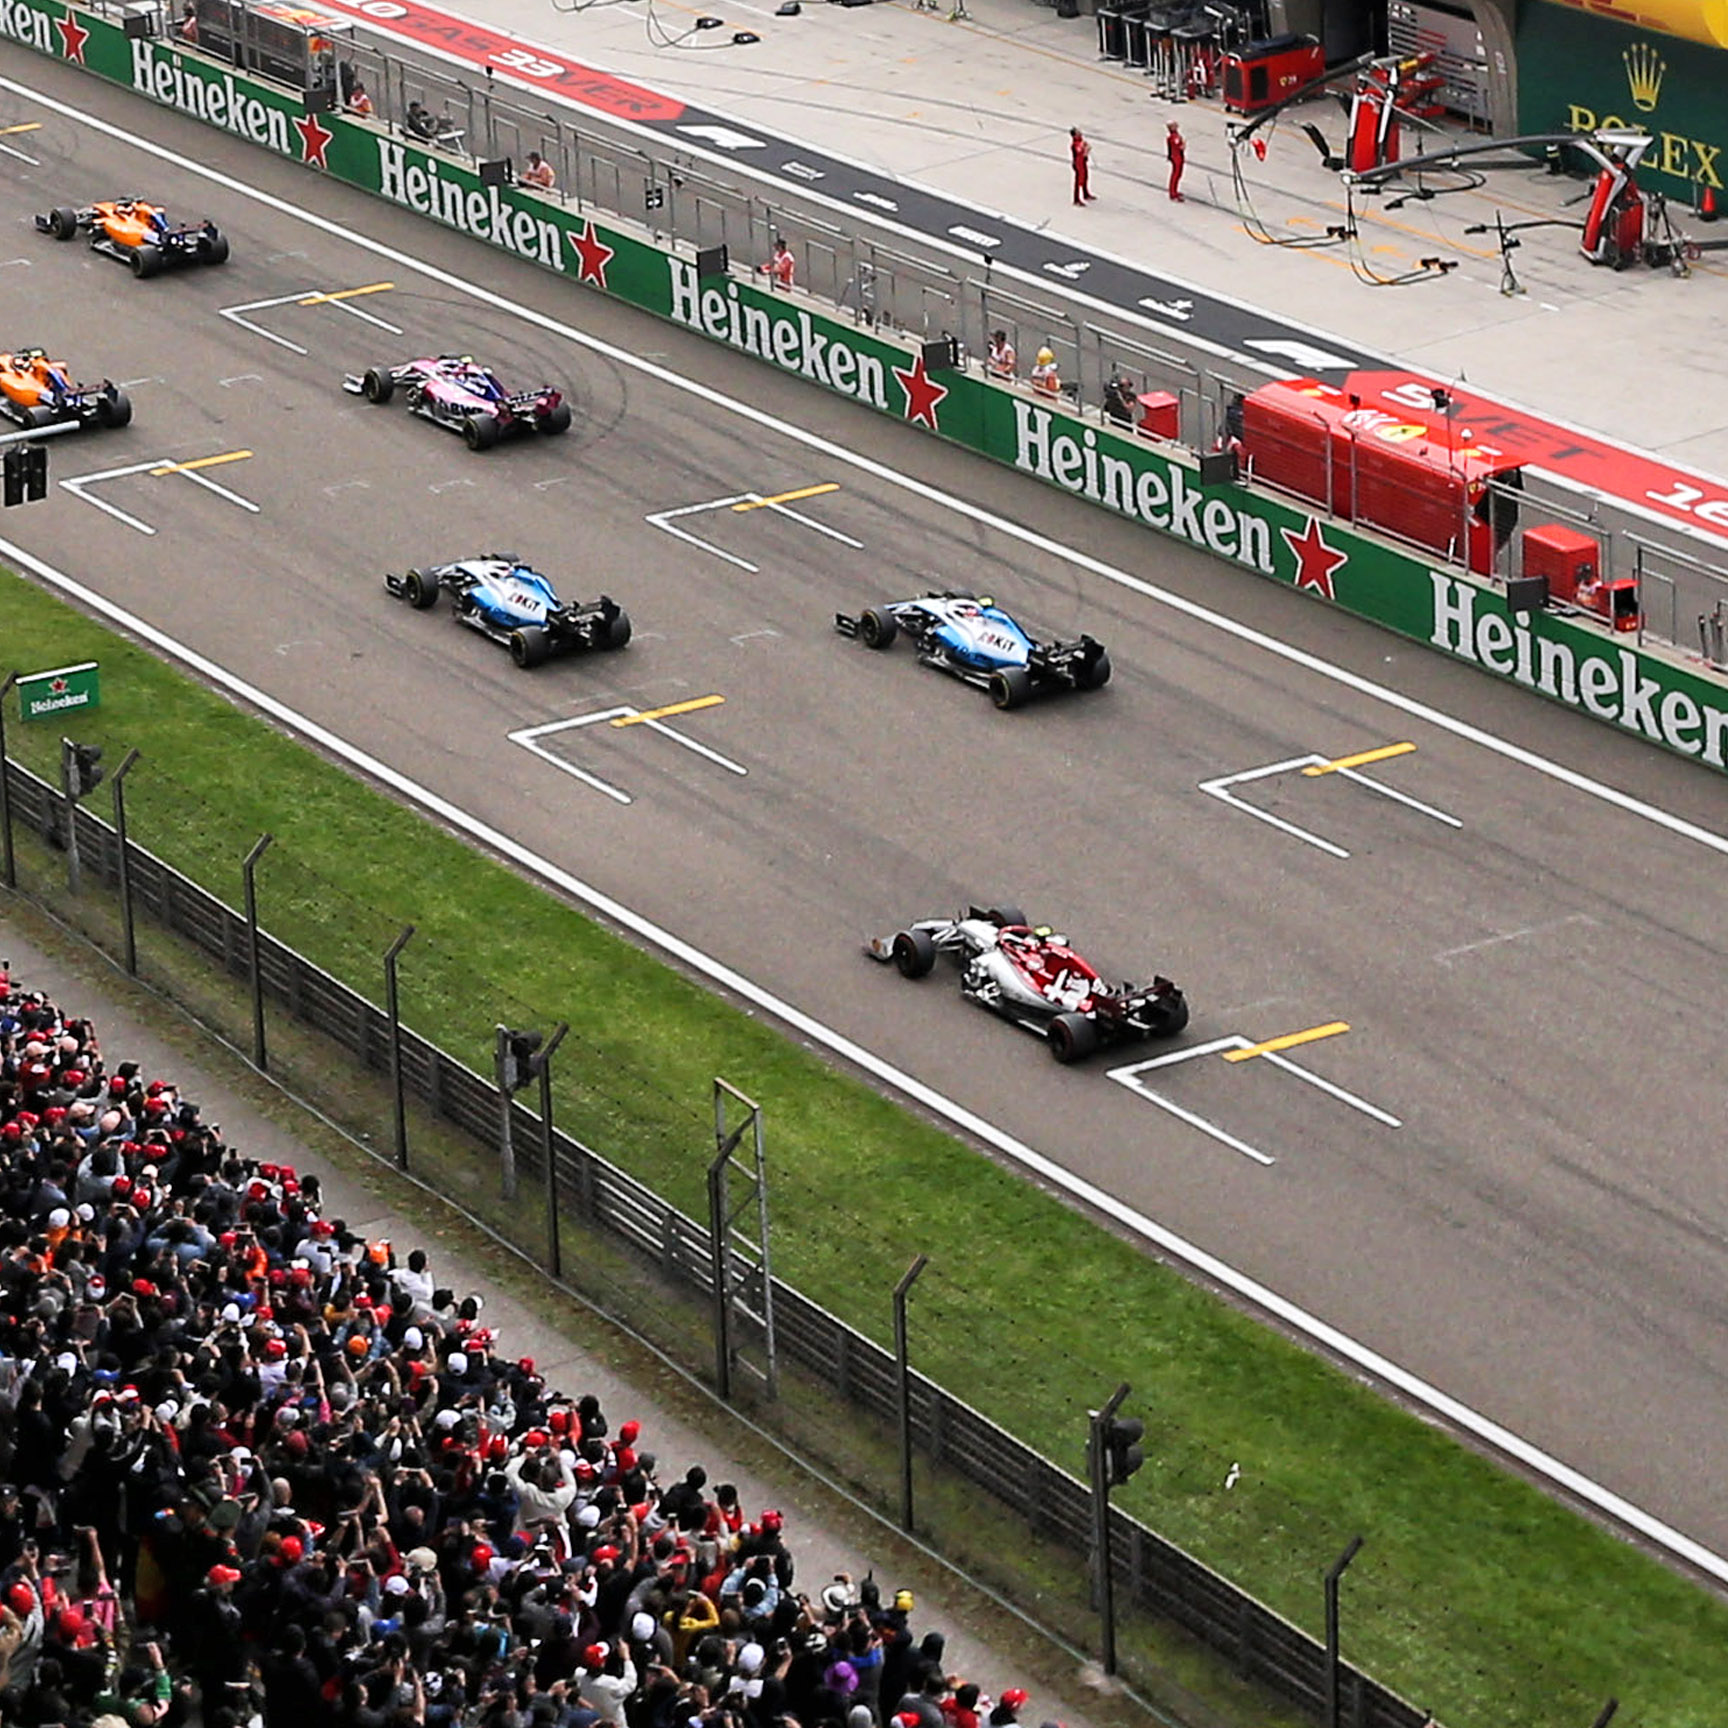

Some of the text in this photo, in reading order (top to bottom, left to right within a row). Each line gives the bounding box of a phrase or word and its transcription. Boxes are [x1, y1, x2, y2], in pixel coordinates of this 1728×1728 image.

[131, 37, 292, 154] Heineken
[488, 48, 565, 77] 33
[376, 138, 565, 273] Heineken
[668, 256, 888, 408] Heineken
[1015, 398, 1275, 575] Heineken
